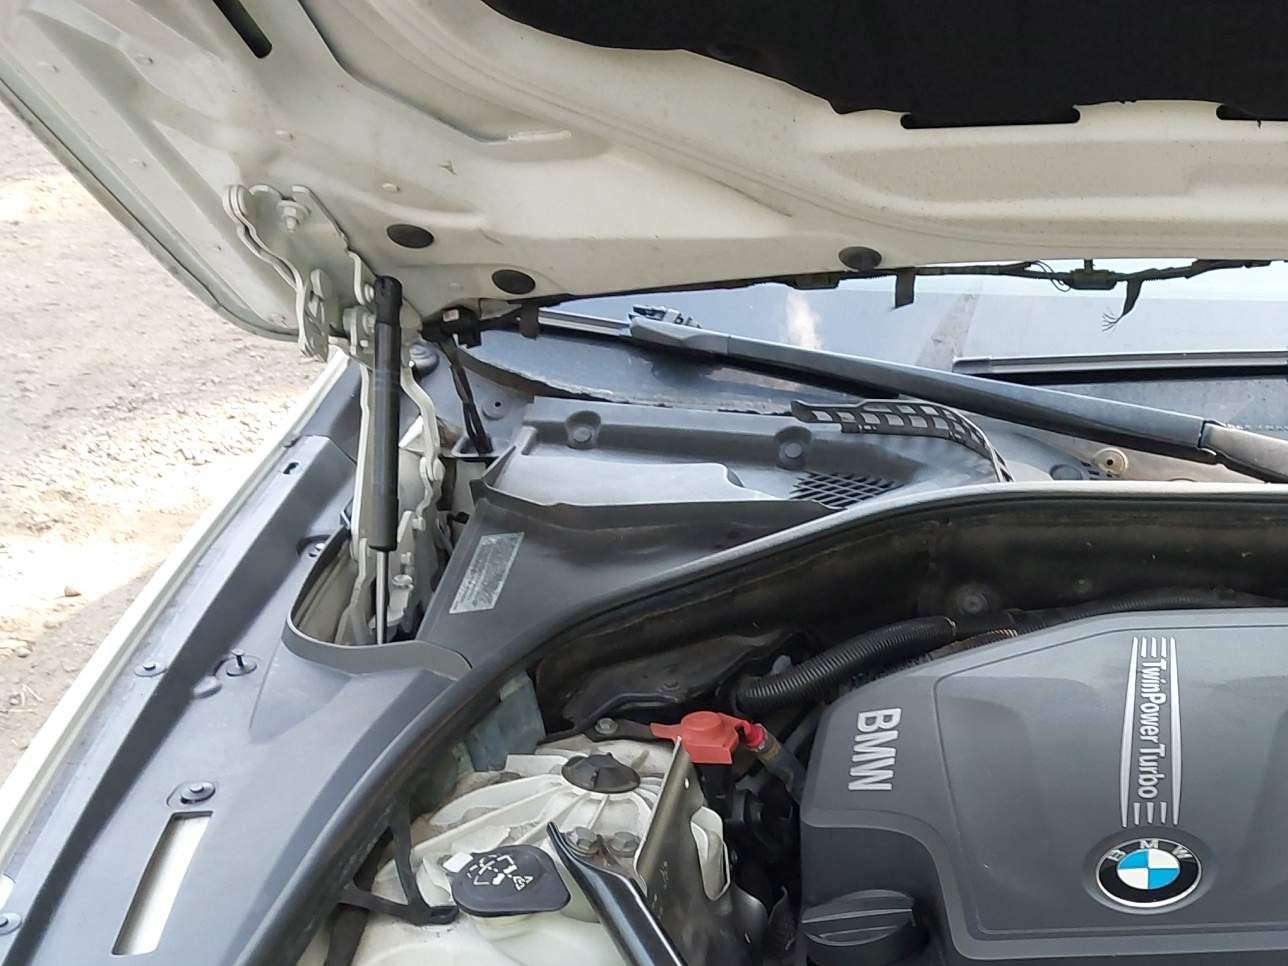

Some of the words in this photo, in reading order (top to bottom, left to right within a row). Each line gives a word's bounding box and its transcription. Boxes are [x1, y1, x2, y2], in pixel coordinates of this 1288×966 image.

[1140, 658, 1167, 743] TwinPower
[848, 707, 902, 791] BMW
[1137, 743, 1166, 799] Turbo
[1106, 839, 1193, 862] BMW
